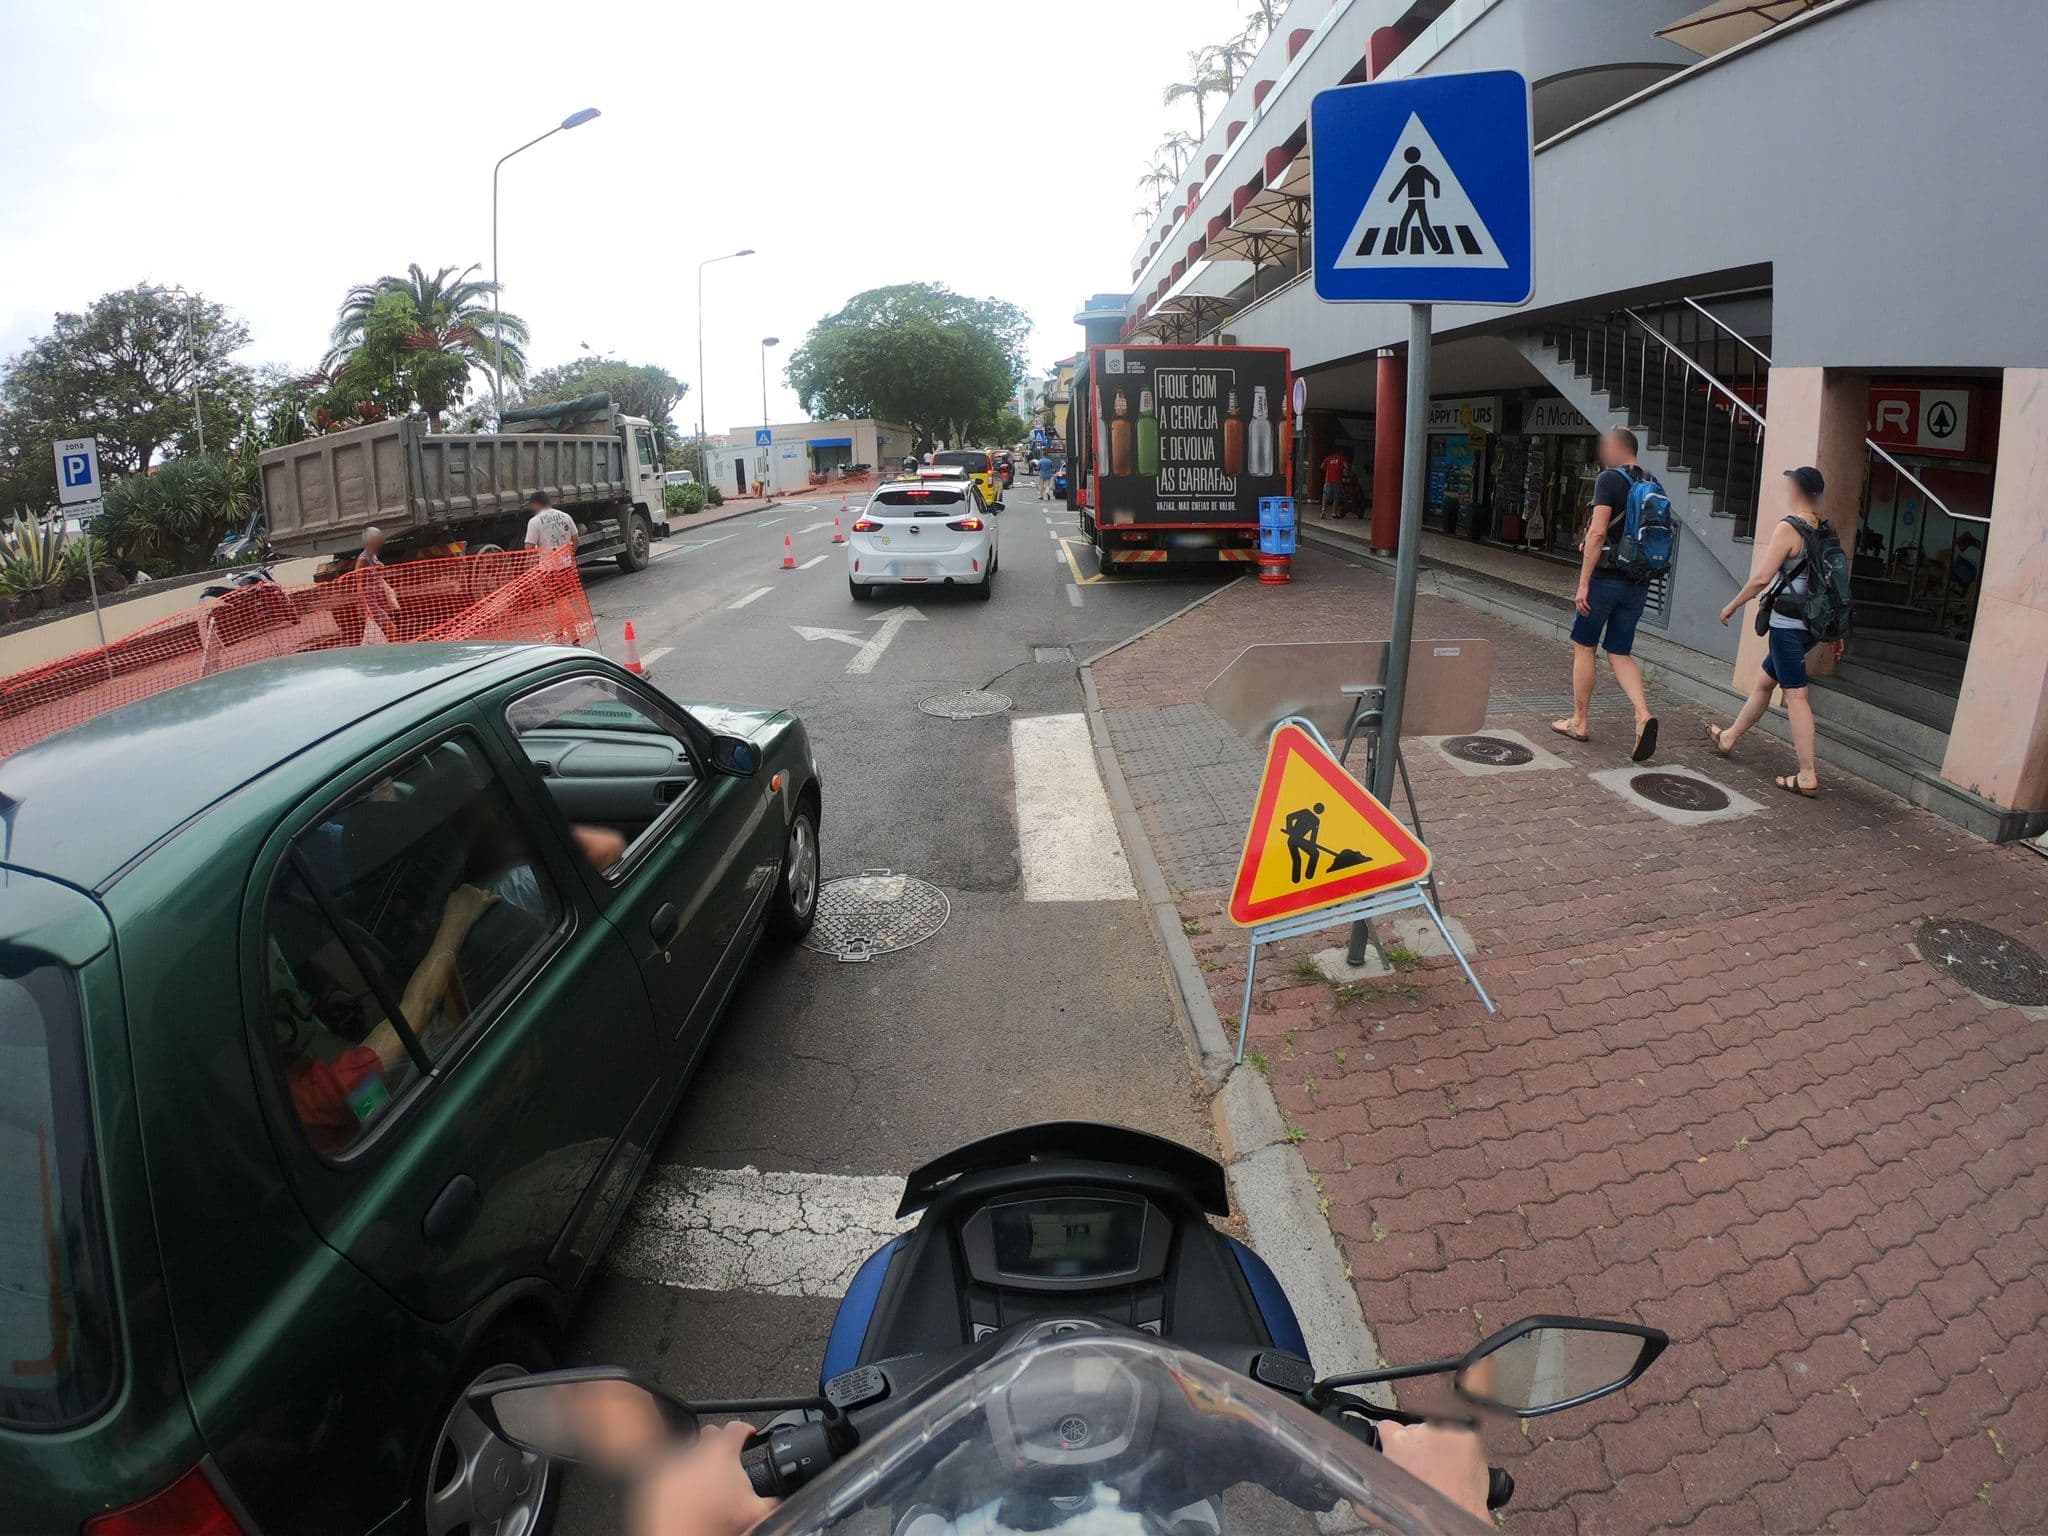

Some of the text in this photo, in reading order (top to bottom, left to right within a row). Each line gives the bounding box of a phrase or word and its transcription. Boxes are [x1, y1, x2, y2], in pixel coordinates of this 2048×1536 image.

[1159, 374, 1217, 399] FIQUE COM
[1160, 405, 1219, 430] A CERVEJA
[1428, 409, 1451, 424] APPY
[1536, 406, 1545, 426] A
[1866, 400, 1909, 434] R
[65, 443, 85, 451] zona
[1160, 436, 1216, 461] E DEVOLVA
[68, 457, 85, 485] P
[1160, 467, 1234, 492] AS GARRAFAS
